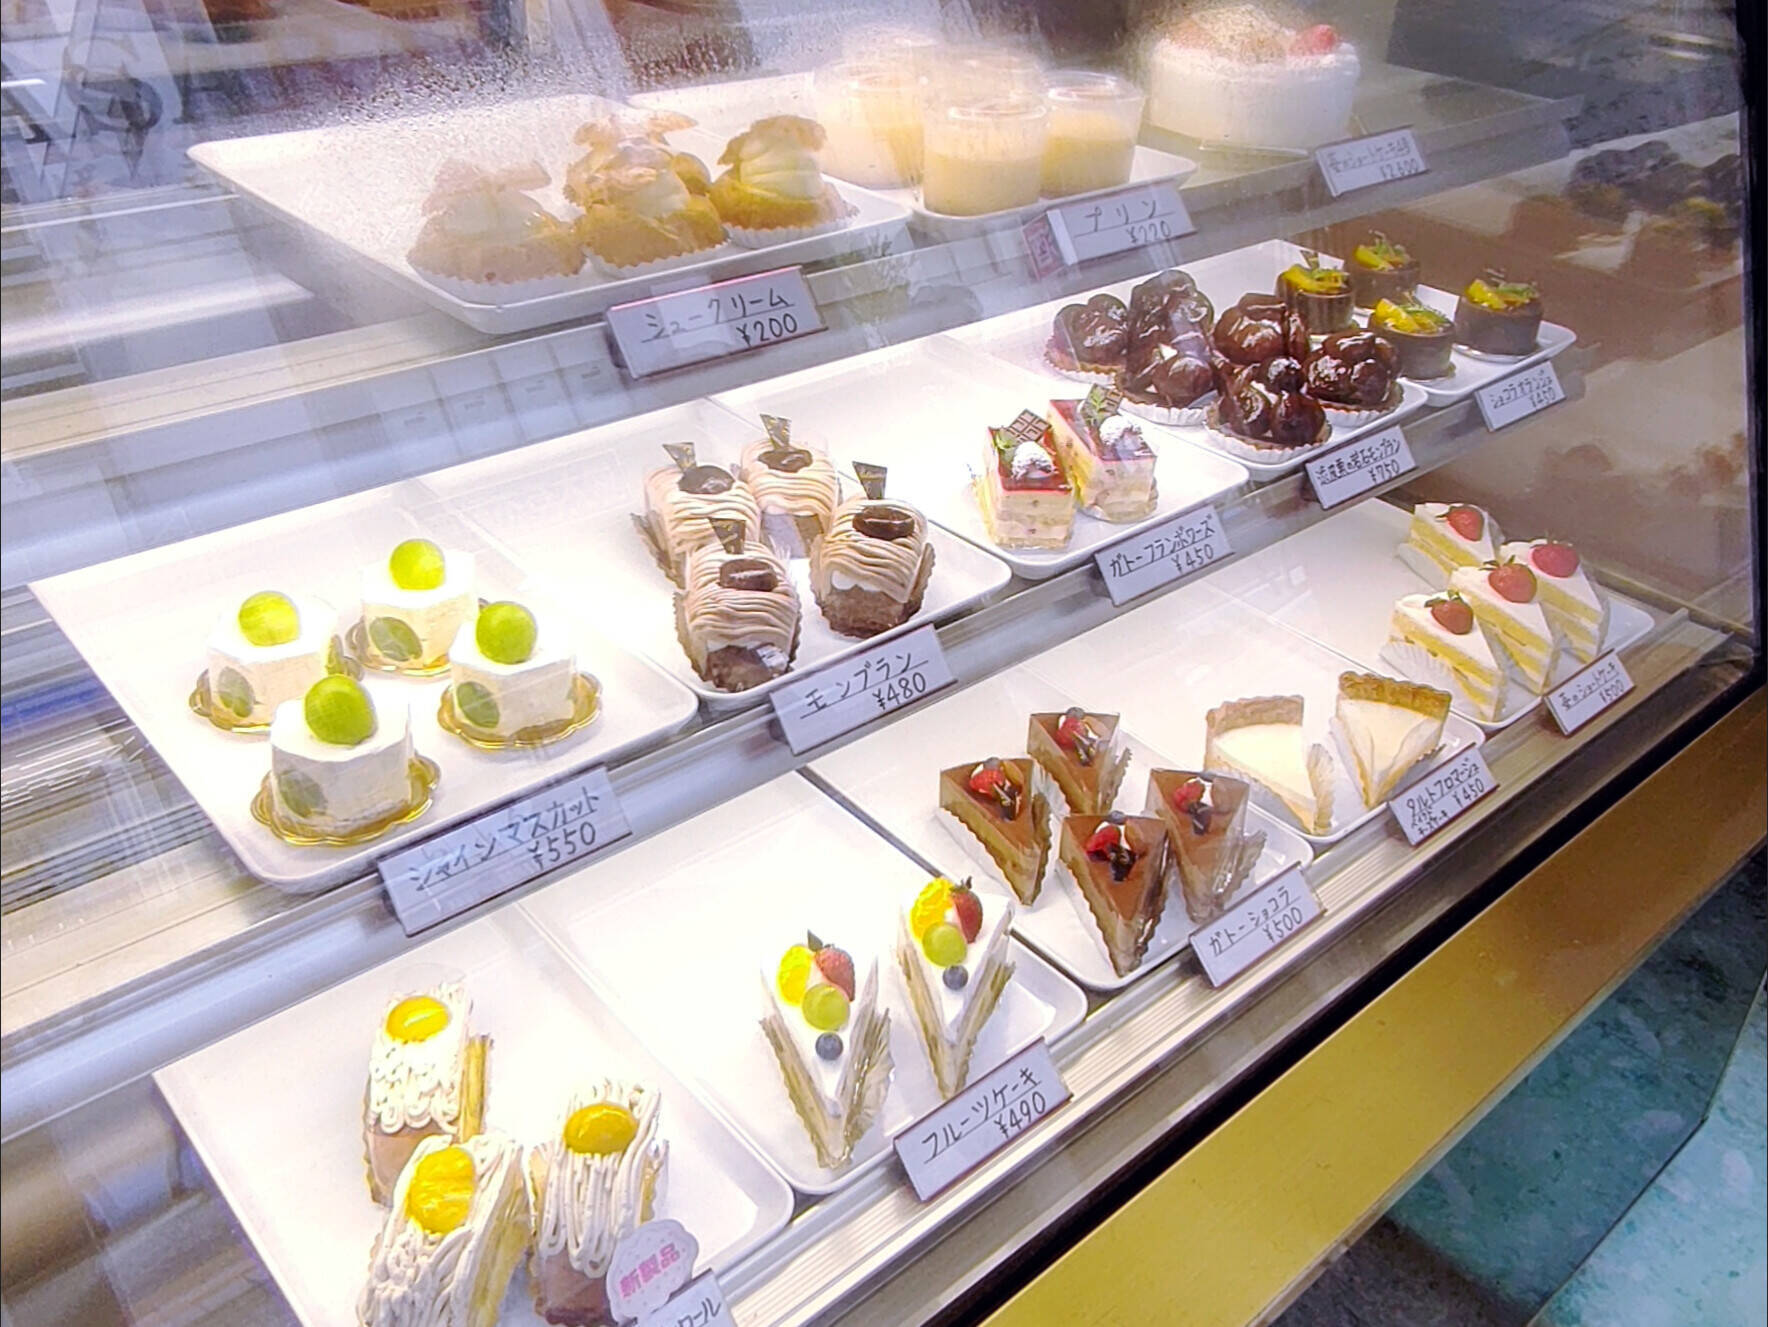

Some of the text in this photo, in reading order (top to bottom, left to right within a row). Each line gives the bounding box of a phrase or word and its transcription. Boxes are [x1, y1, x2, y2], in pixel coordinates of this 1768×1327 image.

[1085, 199, 1157, 233] プリン
[1126, 220, 1172, 245] ¥220
[644, 288, 791, 339] シュークリーム
[735, 312, 798, 347] ¥200
[1368, 459, 1400, 484] ¥750
[1110, 513, 1216, 577] ガトーフランボワーズ
[1171, 543, 1214, 573] ¥450
[805, 653, 912, 711] モンブラン
[872, 672, 926, 710] ¥480
[1406, 757, 1480, 816] タルトフロマージュ
[1452, 778, 1485, 808] ¥450
[409, 786, 600, 891] シャインマスカット
[526, 822, 597, 870] ¥550
[1209, 886, 1290, 957] ガトーショコラ
[1262, 906, 1303, 943] ¥500
[922, 1067, 1039, 1159] フルーツケーキ
[994, 1091, 1046, 1139] ¥490
[619, 1243, 680, 1299] 新製品
[675, 1297, 722, 1327] ロール
